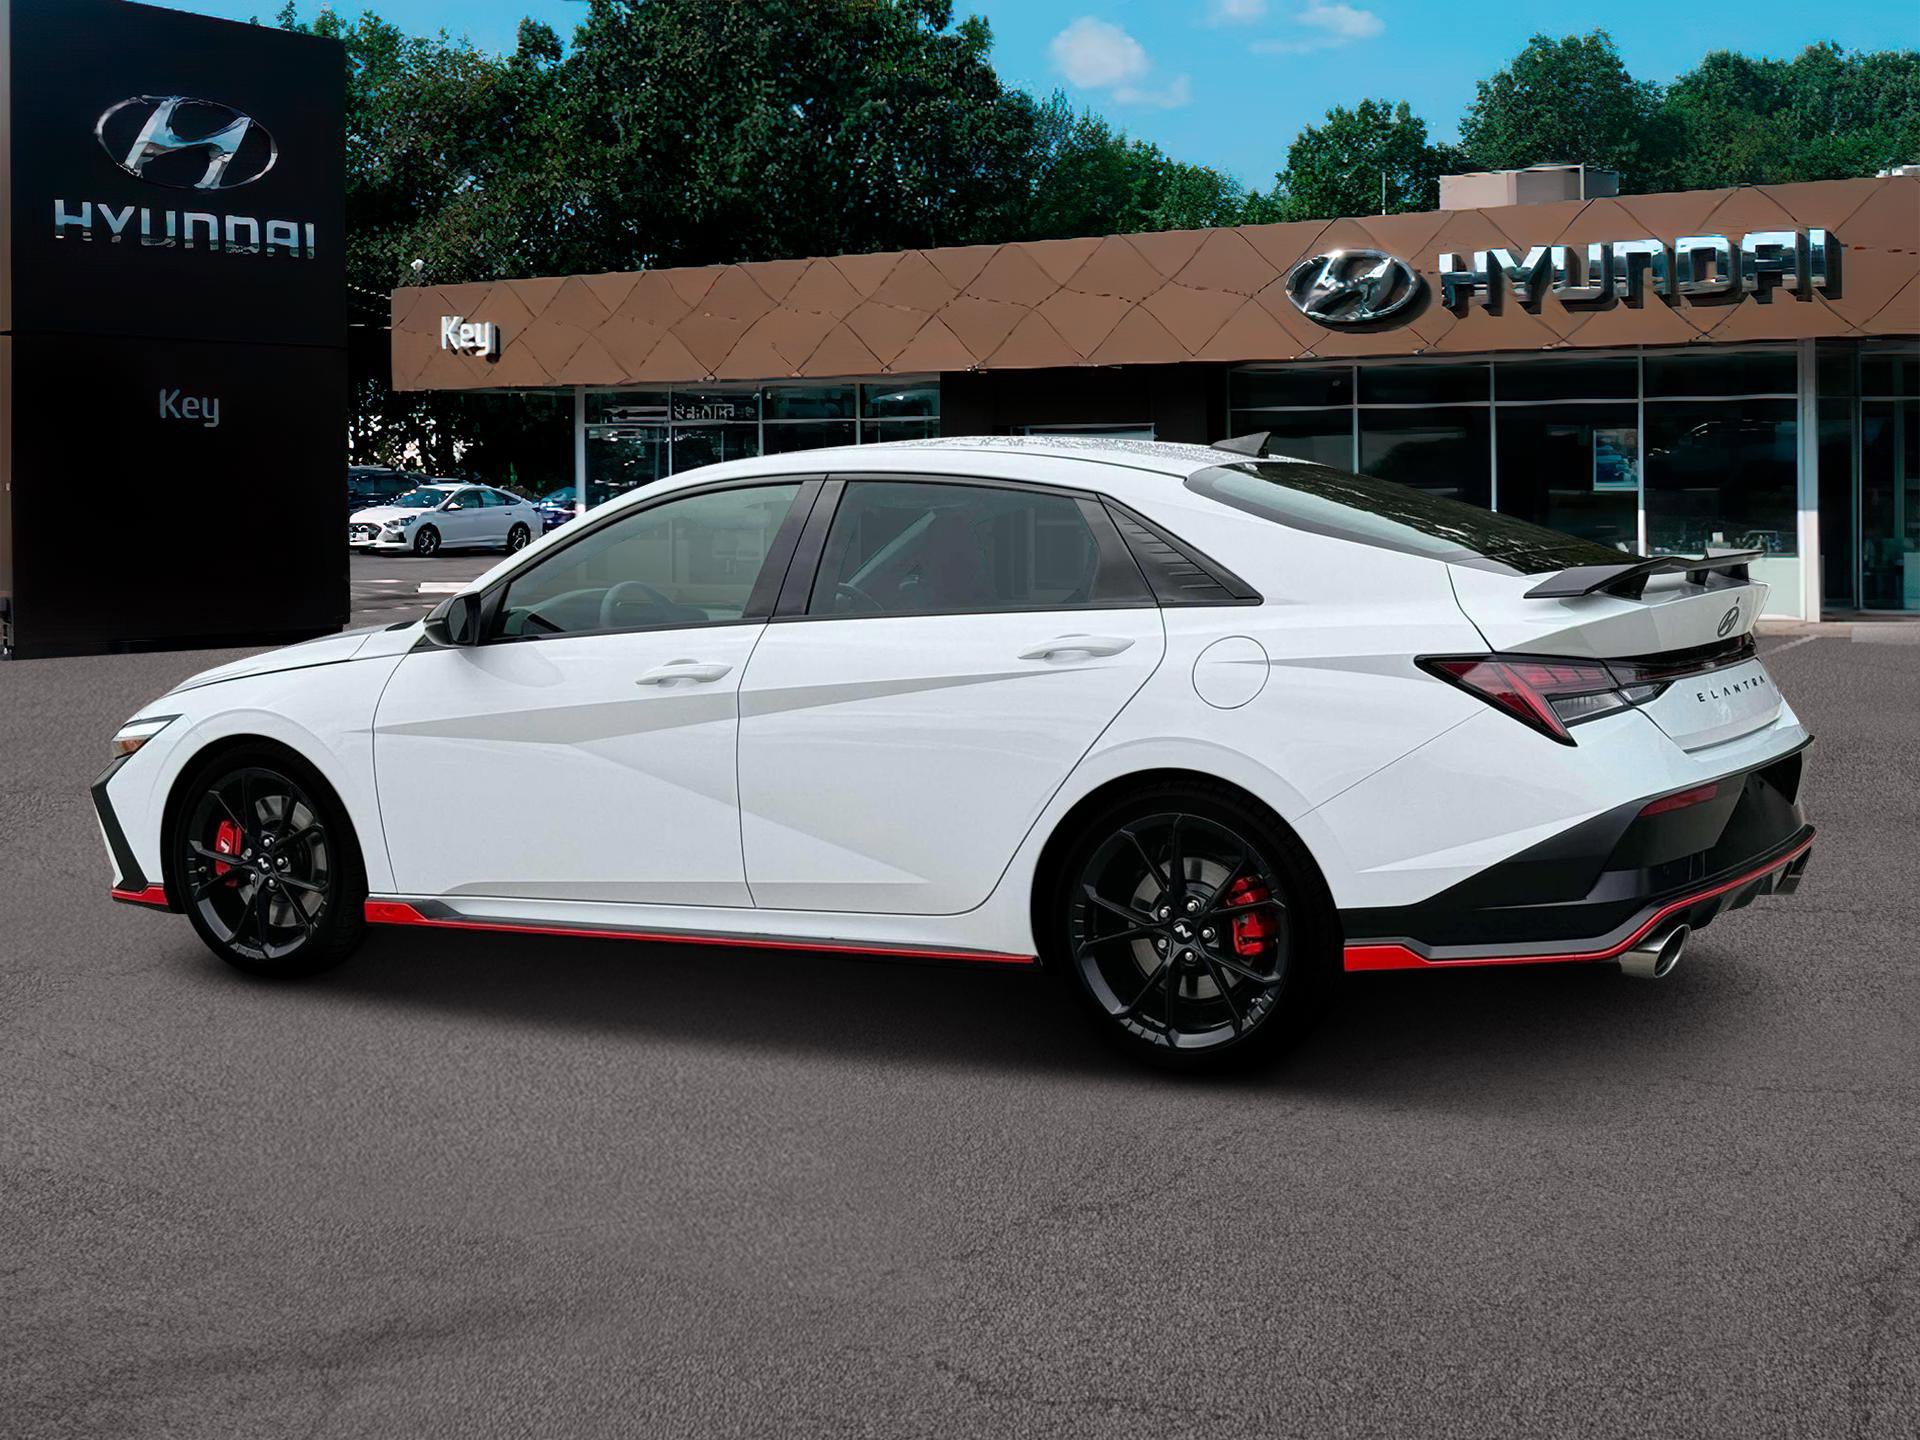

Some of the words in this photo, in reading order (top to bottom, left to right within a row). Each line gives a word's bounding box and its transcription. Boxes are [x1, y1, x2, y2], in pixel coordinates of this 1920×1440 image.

[54, 199, 315, 260] HYUNDAI
[1438, 228, 1838, 316] HYUNDAI
[440, 315, 495, 357] Key
[159, 388, 220, 428] Key
[1696, 675, 1766, 703] ELANTRA
